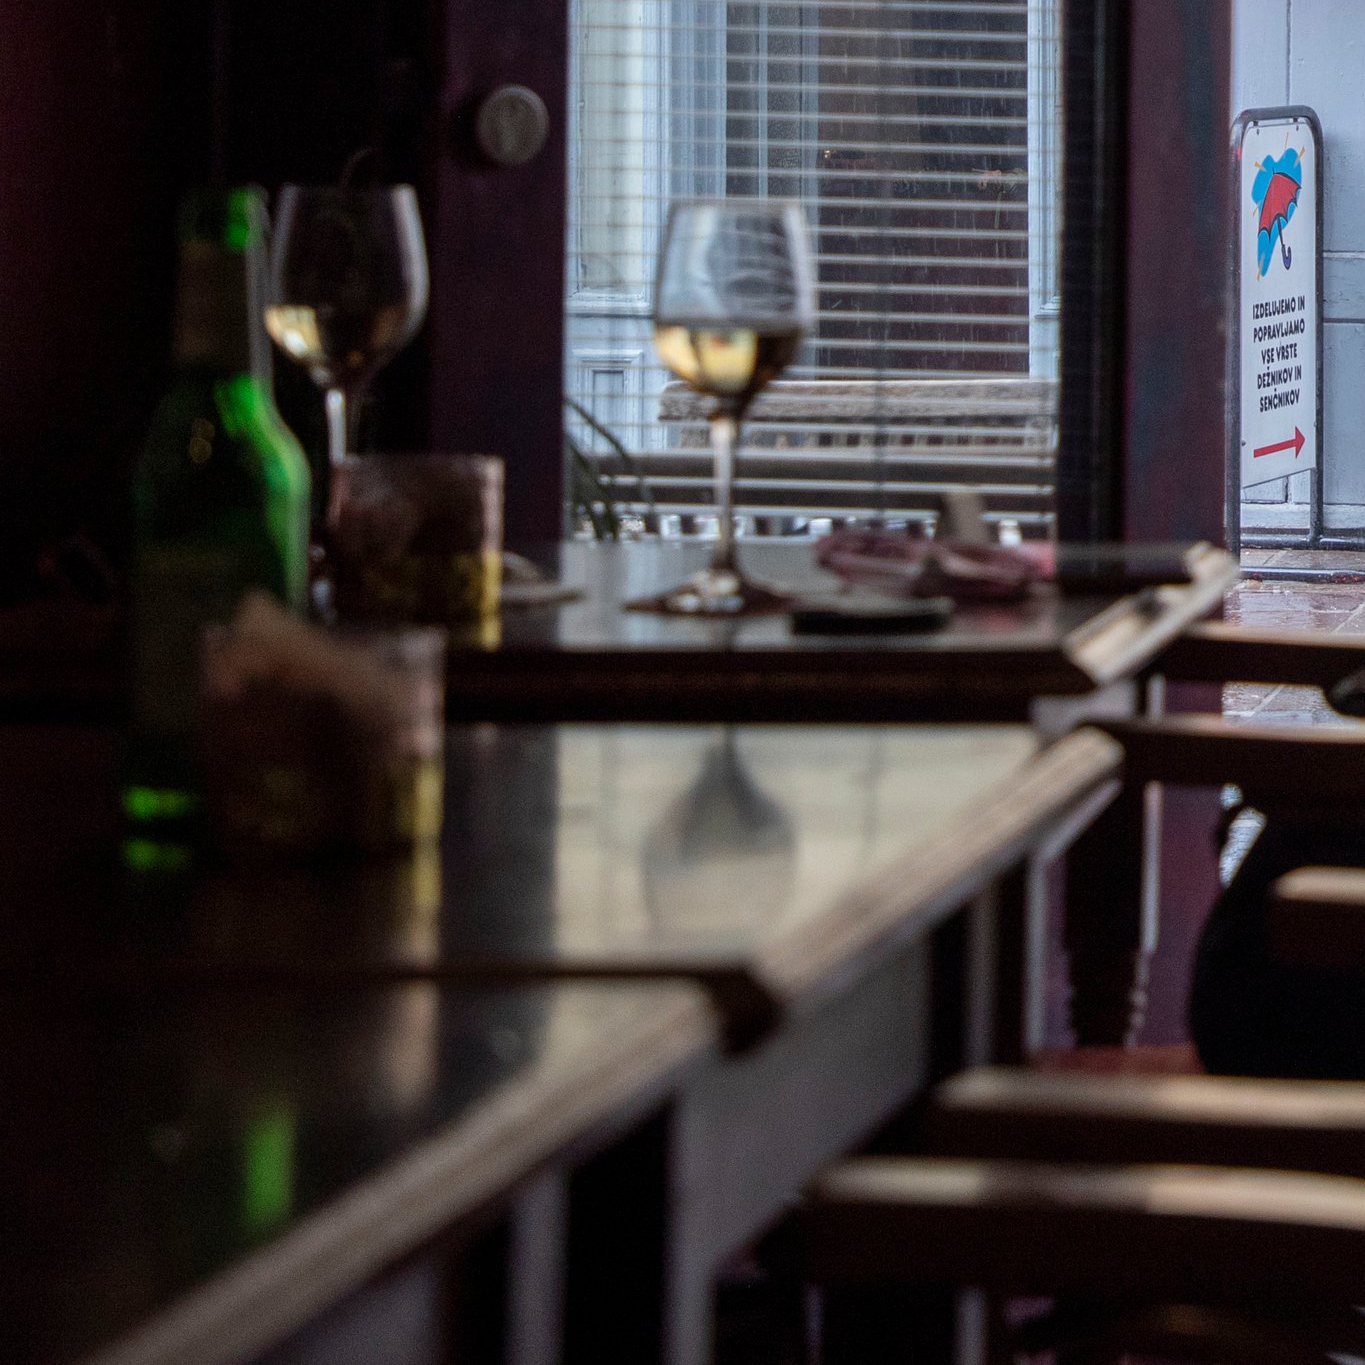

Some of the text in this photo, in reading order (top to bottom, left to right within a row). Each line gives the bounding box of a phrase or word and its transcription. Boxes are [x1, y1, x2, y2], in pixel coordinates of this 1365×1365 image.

[1252, 295, 1305, 320] IZDELUJEMO IN
[1253, 318, 1306, 343] POPRAVLJAMO
[1261, 342, 1298, 365] VSE VRSTE
[1257, 365, 1302, 390] DEŽNIKOV IN
[1259, 387, 1300, 413] SENČNIKOV
